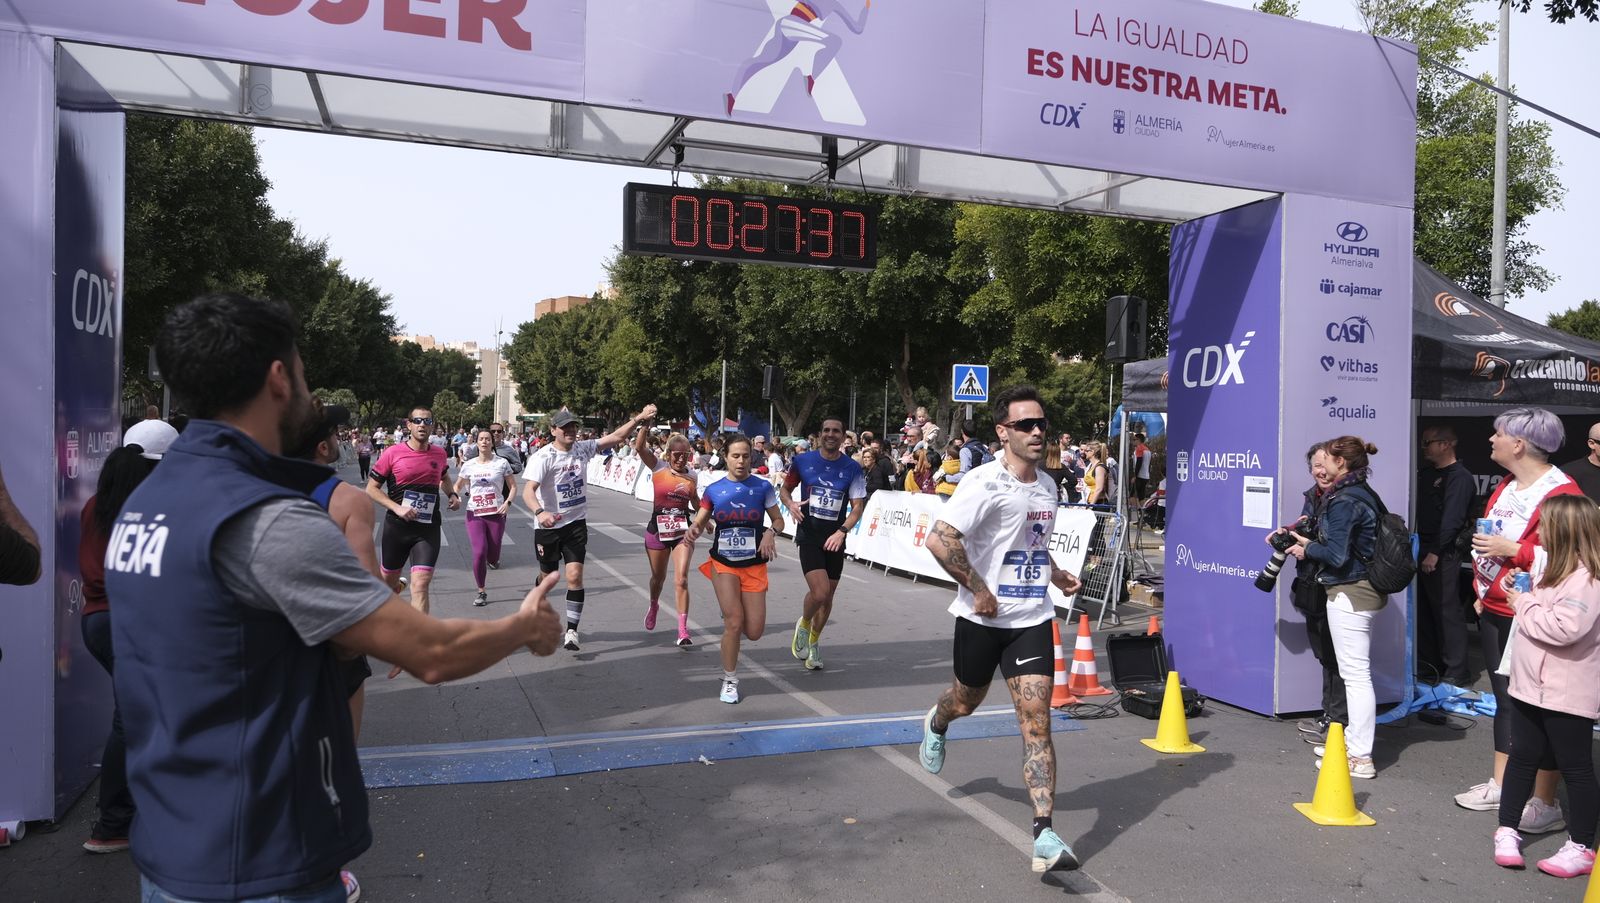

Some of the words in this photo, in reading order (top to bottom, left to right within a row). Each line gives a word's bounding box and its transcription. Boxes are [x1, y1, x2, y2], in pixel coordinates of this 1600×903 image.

[1075, 9, 1107, 41] LA
[1117, 17, 1249, 65] IGUALDAD
[1027, 48, 1064, 79] ES
[1071, 55, 1202, 103] NUESTRA
[1208, 79, 1287, 115] META.
[1040, 102, 1086, 129] CDX
[1135, 113, 1183, 133] ALMERÍA
[1135, 127, 1160, 138] CIUDAD
[671, 195, 865, 260] 00:27:37
[1324, 242, 1380, 259] HYUNDAI
[1331, 256, 1374, 269] Almerialva
[1338, 282, 1383, 297] cajamar
[1326, 318, 1366, 344] CASI
[1182, 331, 1256, 388] CDX
[1338, 358, 1378, 374] vithas
[1553, 382, 1600, 394] cronometraj
[1329, 404, 1376, 422] aqualia
[1198, 449, 1261, 469] ALMERÍA
[1198, 470, 1228, 481] CIUDAD
[562, 488, 582, 499] 2045
[410, 500, 428, 510] 454
[817, 496, 834, 507] 191
[1026, 511, 1053, 521] MUJER
[664, 522, 681, 530] 924
[726, 537, 747, 547] 190
[1048, 530, 1080, 554] ERÍA
[1014, 565, 1041, 580] 165
